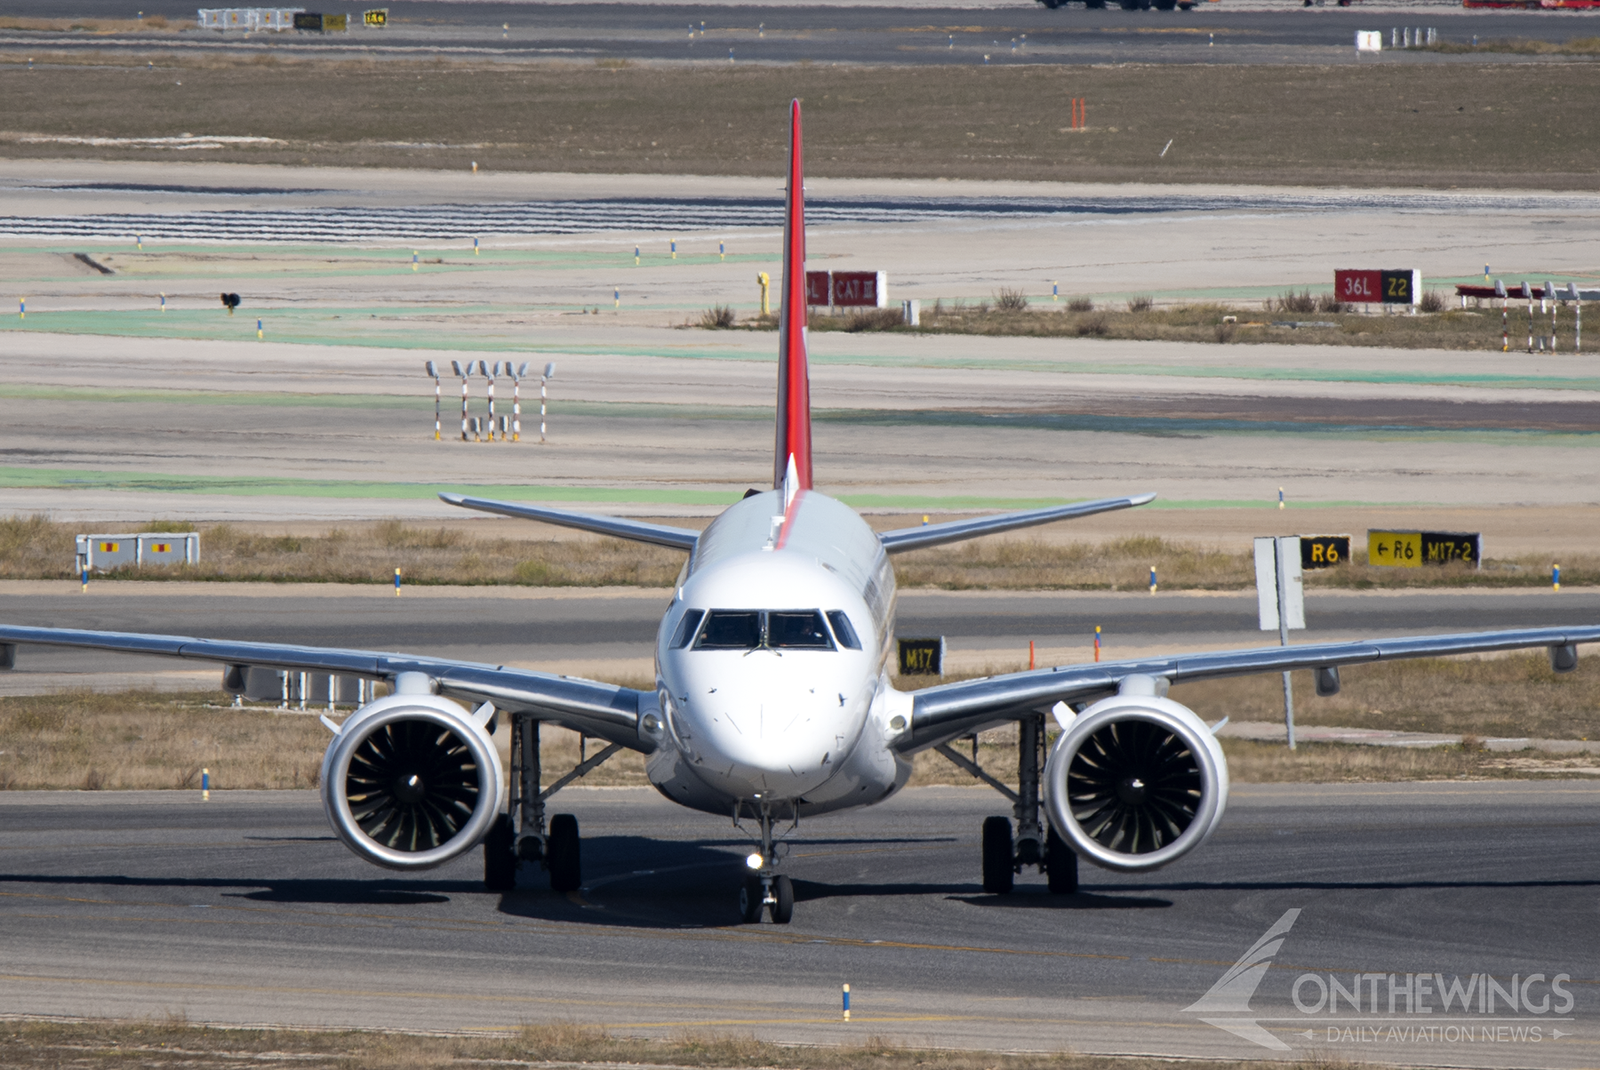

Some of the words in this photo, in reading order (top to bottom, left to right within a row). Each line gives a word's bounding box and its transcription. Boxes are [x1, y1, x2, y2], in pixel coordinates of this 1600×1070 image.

[836, 279, 859, 299] CAT
[1345, 277, 1372, 296] 36L
[1387, 277, 1407, 297] Z2
[1312, 543, 1338, 562] R6
[1394, 540, 1413, 560] R6
[1427, 541, 1472, 562] M17-2
[906, 648, 934, 669] M17
